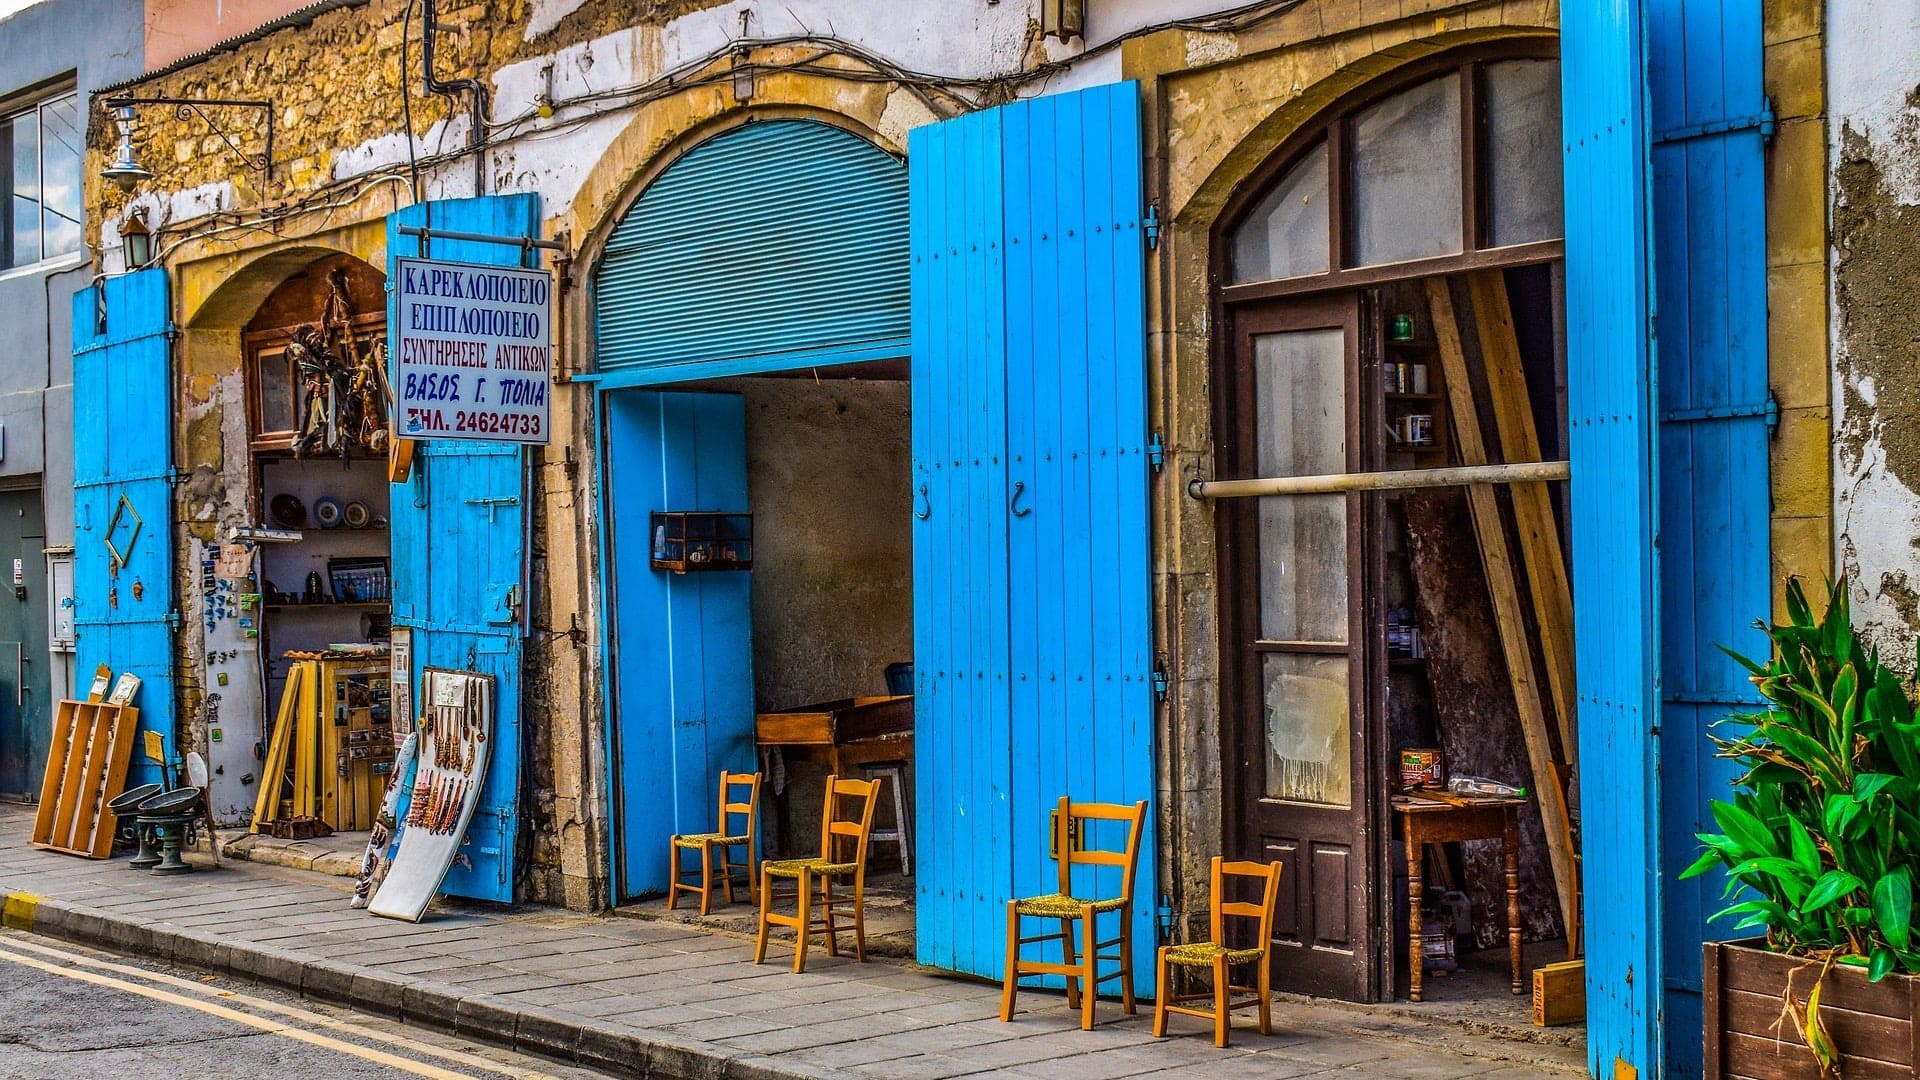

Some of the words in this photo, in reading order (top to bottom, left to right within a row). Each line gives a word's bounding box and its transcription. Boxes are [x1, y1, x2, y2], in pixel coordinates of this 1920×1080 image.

[404, 267, 546, 306] ΚΑΡΕΚΛΟΠΟΙΕΙΟ
[411, 303, 540, 340] ΕΠΙΠΛΟΠΟΙΕΙΟ
[403, 337, 488, 369] ΣΥΝΤΗΡΗΣΕΙΣ
[494, 343, 547, 372] ΑΝΤΙΚΩΝ
[404, 372, 460, 402] ΒΑΣΟΣ
[475, 377, 486, 403] Γ.
[500, 378, 545, 407] ΠΟΛΙΑ
[455, 410, 541, 435] 24624733
